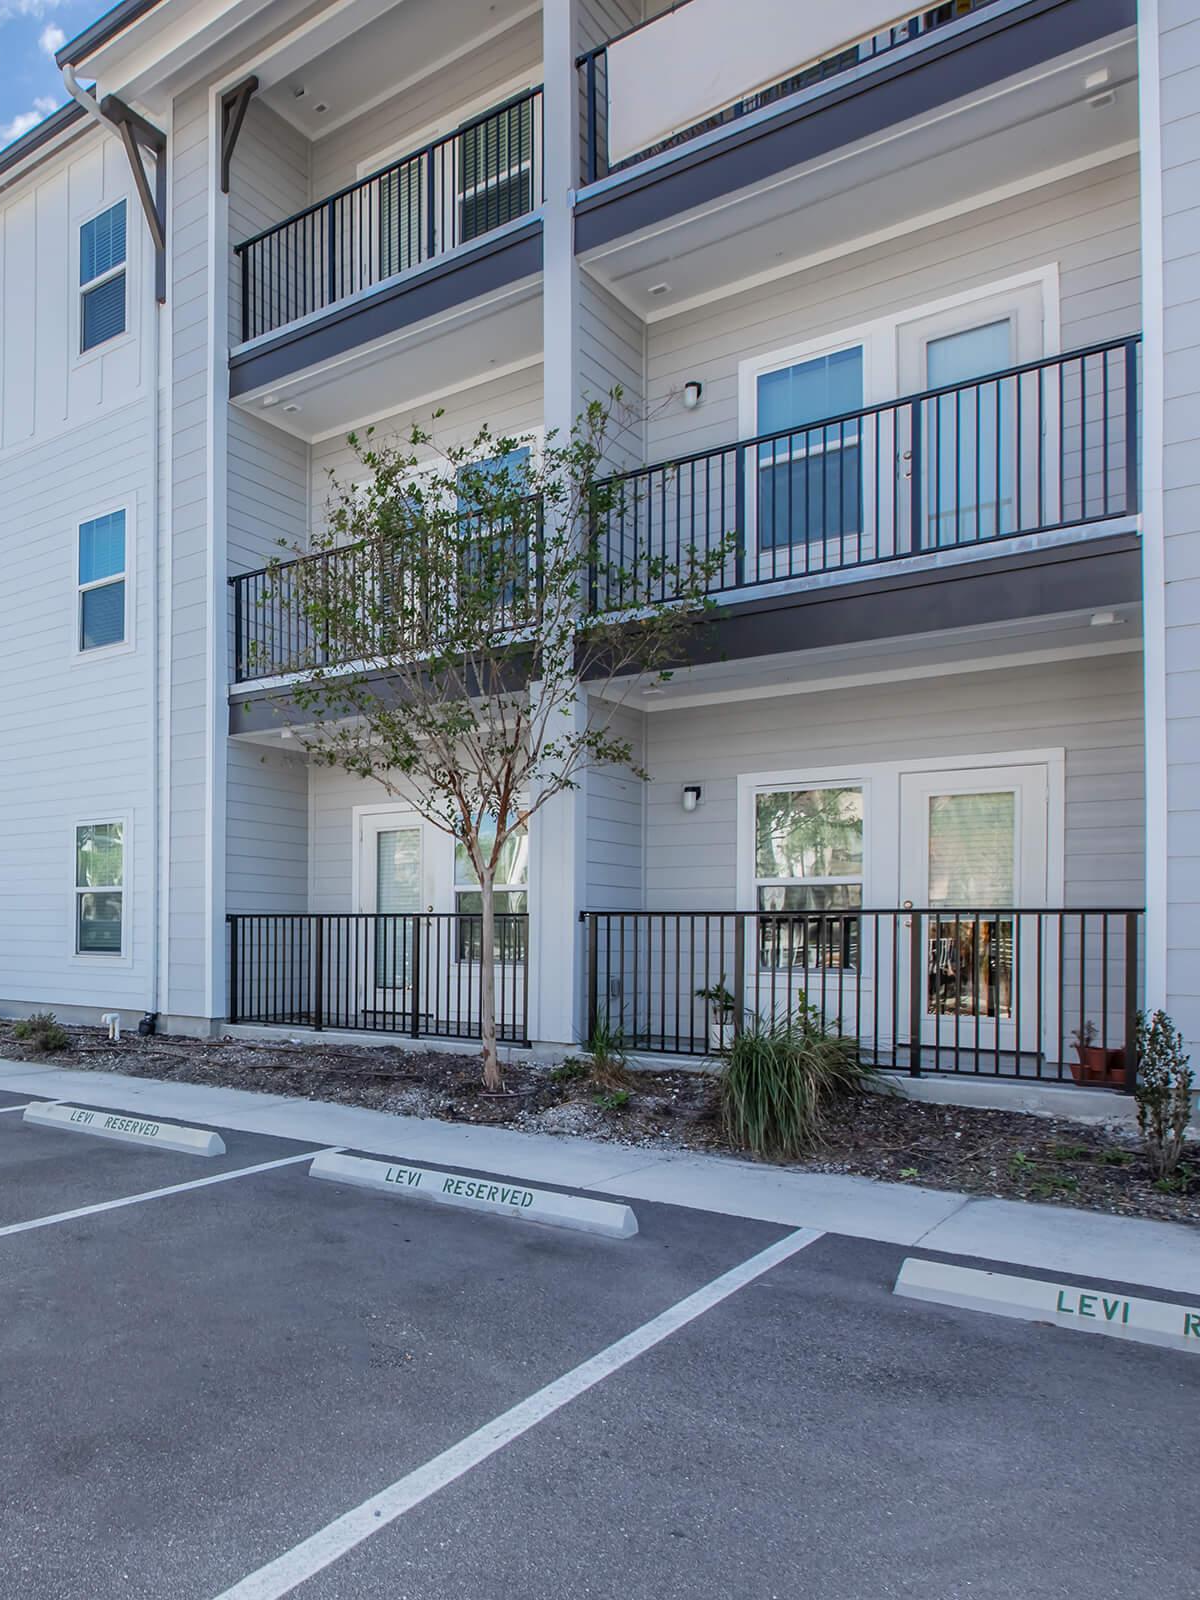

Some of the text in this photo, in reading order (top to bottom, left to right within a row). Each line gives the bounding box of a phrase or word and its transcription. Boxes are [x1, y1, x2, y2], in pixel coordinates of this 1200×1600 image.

[70, 1110, 160, 1137] LEVI RESERVED
[385, 1167, 534, 1208] LEVI RESERVED
[1056, 1290, 1130, 1324] LEVI
